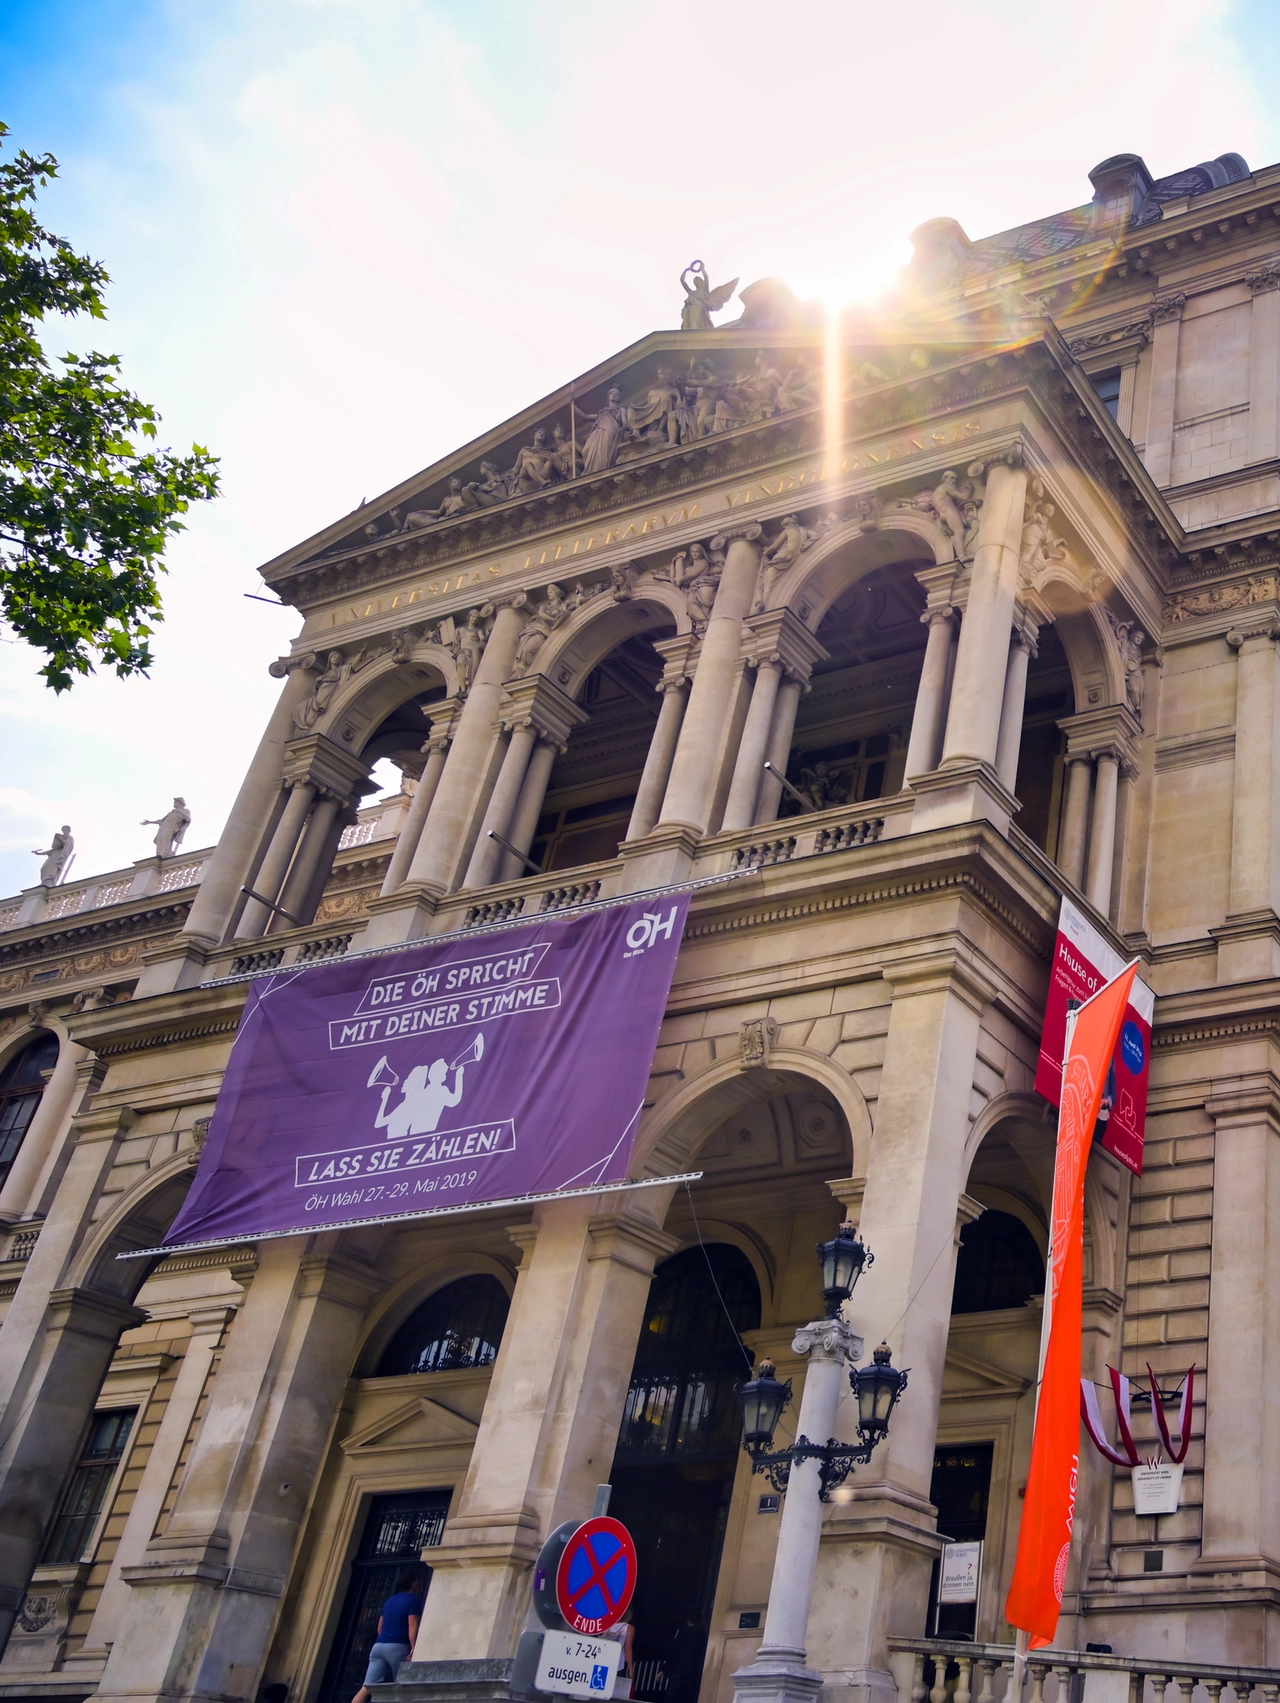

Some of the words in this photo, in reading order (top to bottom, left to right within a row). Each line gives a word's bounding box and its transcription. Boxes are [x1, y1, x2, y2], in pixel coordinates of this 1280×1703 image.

[524, 504, 700, 569] LITTERARVM
[370, 981, 405, 1006] DIE
[411, 972, 440, 997] ÖH
[445, 952, 535, 990] SPRICHT
[1059, 943, 1087, 982] House
[1088, 976, 1098, 992] of
[340, 1019, 382, 1044] MIT
[385, 1003, 460, 1037] DEINER
[465, 985, 549, 1020] STIMME
[308, 1154, 363, 1182] LASS
[366, 1147, 404, 1172] SIE
[406, 1128, 501, 1166] ZÄHLEN!
[304, 1194, 328, 1211] ÖH
[331, 1188, 365, 1207] Wahl
[364, 1182, 410, 1203] 27.-29.
[414, 1176, 439, 1194] Mai
[440, 1170, 477, 1190] 2019
[573, 1614, 603, 1633] ENDE
[548, 1665, 589, 1684] ausgen.
[566, 1646, 572, 1656] v.
